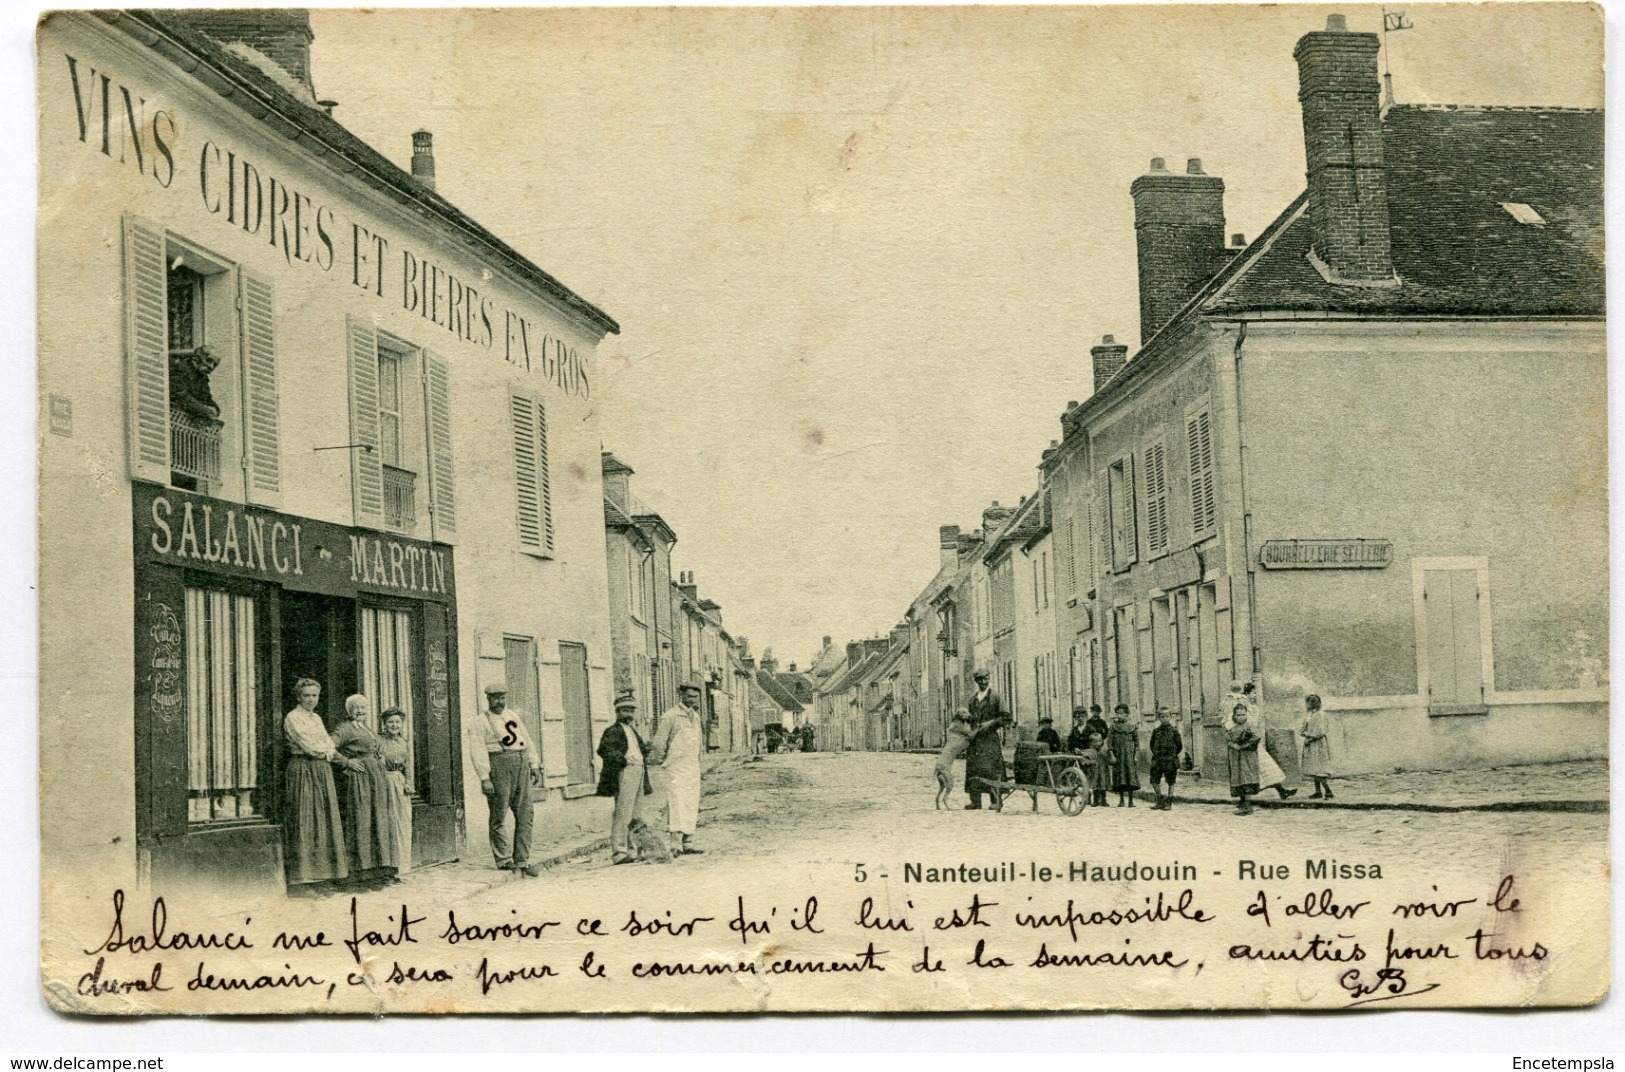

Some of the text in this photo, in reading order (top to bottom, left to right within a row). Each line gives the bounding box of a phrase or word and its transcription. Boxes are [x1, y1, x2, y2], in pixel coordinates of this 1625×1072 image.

[65, 54, 174, 188] VINS
[200, 140, 335, 272] CIDRES
[352, 222, 389, 298] ET
[505, 309, 532, 374] EN
[541, 332, 591, 402] GROS
[151, 496, 304, 576] SALANCI
[349, 534, 448, 595] MARTIN
[502, 720, 524, 747] S.
[854, 863, 868, 883] 5
[904, 860, 1197, 884] Nanteuil-le-Haudouin
[1239, 859, 1290, 880] Rue
[1306, 859, 1384, 880] Missa
[84, 889, 254, 955] Salanci
[272, 930, 333, 951] me
[344, 897, 427, 963] fait
[438, 909, 562, 944] savoir
[576, 917, 609, 937] ce
[620, 909, 715, 937] soir
[854, 896, 915, 932] lui
[933, 893, 999, 931] est
[1015, 888, 1217, 946] impossible
[1246, 888, 1371, 927] d'aller
[1392, 884, 1478, 918] voir
[1487, 874, 1522, 913] le
[187, 961, 337, 999] demain,
[384, 961, 454, 986] sera
[475, 957, 560, 995] pour
[579, 951, 608, 978] le
[912, 946, 947, 974] de
[966, 938, 1014, 969] la
[1028, 940, 1205, 976] semaine,
[1380, 928, 1460, 968] pour
[1465, 928, 1549, 962] tous
